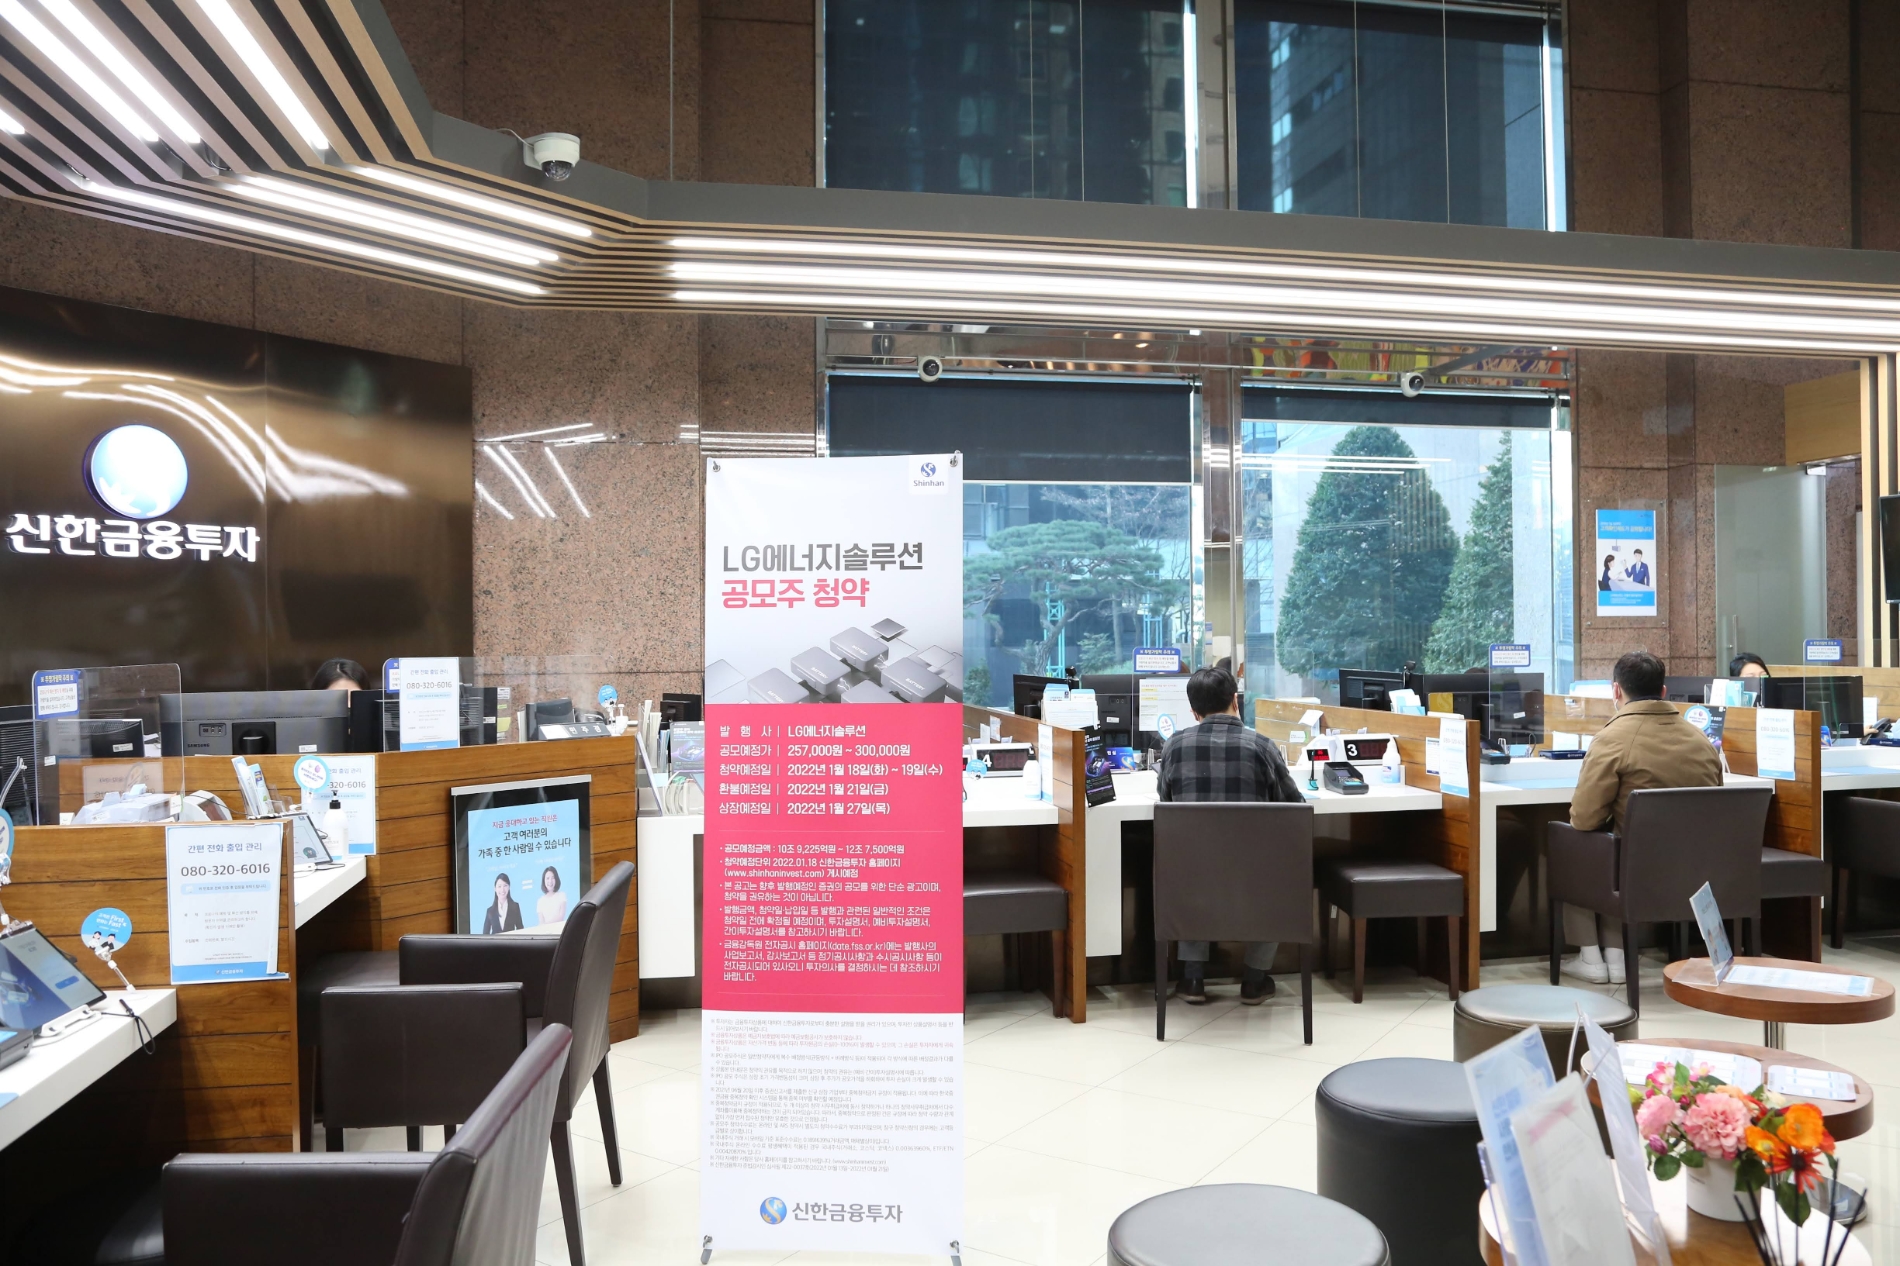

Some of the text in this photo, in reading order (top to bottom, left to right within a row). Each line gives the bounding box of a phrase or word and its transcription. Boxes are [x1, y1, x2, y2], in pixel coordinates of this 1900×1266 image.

[913, 479, 945, 488] Shinhan
[5, 513, 261, 563] 신한금융투자
[723, 542, 923, 572] LG에너지솔루션
[721, 577, 870, 609] 공모주 청약
[406, 681, 453, 690] 080-320-6016
[905, 677, 926, 691] BATTERY
[787, 724, 866, 738] LG에너지솔루션
[720, 744, 772, 757] 공모예정가
[787, 744, 843, 758] 257,000원
[854, 744, 911, 758] 300,000원
[1347, 743, 1358, 757] 3
[981, 754, 992, 768] 4
[719, 763, 772, 776] 청약예정일
[787, 763, 826, 776] 2022년
[828, 764, 845, 776] 1월
[847, 763, 889, 776] 18일(화)
[901, 763, 943, 776] 19일(수)
[327, 781, 367, 789] -320-6016
[719, 783, 889, 796] 환불예정일 2022년 1월 21일(금)
[719, 802, 891, 815] 상장예정일 2022년 1월 27일(목)
[492, 820, 504, 829] 지금
[503, 827, 548, 841] 고객 여러분의
[187, 842, 262, 854] 간편 전화 출입 관리
[478, 837, 572, 859] 가족 중 한 사람일 수 있습니다
[724, 844, 771, 853] 공모예정금액
[777, 844, 795, 854] 10조
[796, 844, 836, 854] 9,225억원
[845, 844, 864, 854] 12조
[865, 844, 905, 854] 7,500억원
[724, 857, 901, 868] 청약예정단위 2022.01.18 신한금융투자 홈페이지
[180, 863, 271, 877] 080-320-6016
[826, 868, 859, 878] 게시예정
[734, 881, 758, 891] 공고는
[777, 882, 817, 891] 발행예정인
[870, 882, 887, 892] 위한
[888, 882, 905, 892] 단순
[906, 882, 942, 893] 광고이며,
[749, 892, 781, 901] 권유하는
[782, 892, 799, 902] 것이
[800, 892, 835, 902] 아닙니다.
[820, 906, 845, 916] 발행과
[846, 906, 871, 916] 관련된
[872, 906, 905, 916] 일반적인
[906, 906, 931, 916] 조건은
[749, 916, 765, 925] 전에
[792, 916, 827, 927] 예정이며,
[828, 917, 871, 927] 투자설명서,
[788, 927, 828, 937] 참고하시기
[829, 928, 864, 937] 바랍니다.
[723, 939, 763, 949] 금융감독원
[764, 940, 796, 950] 전자공시
[904, 941, 937, 951] 발행사의
[723, 950, 765, 960] 사업보고서,
[766, 951, 807, 961] 감사보고서
[876, 952, 925, 962] 수시공시사항
[926, 952, 943, 962] 등이
[723, 960, 941, 972] 전자공시되어 있사오니 투자의사를 결정하시는 데 참조하시기
[723, 971, 757, 981] 바랍니다.
[792, 1202, 903, 1224] 신한금융투자
